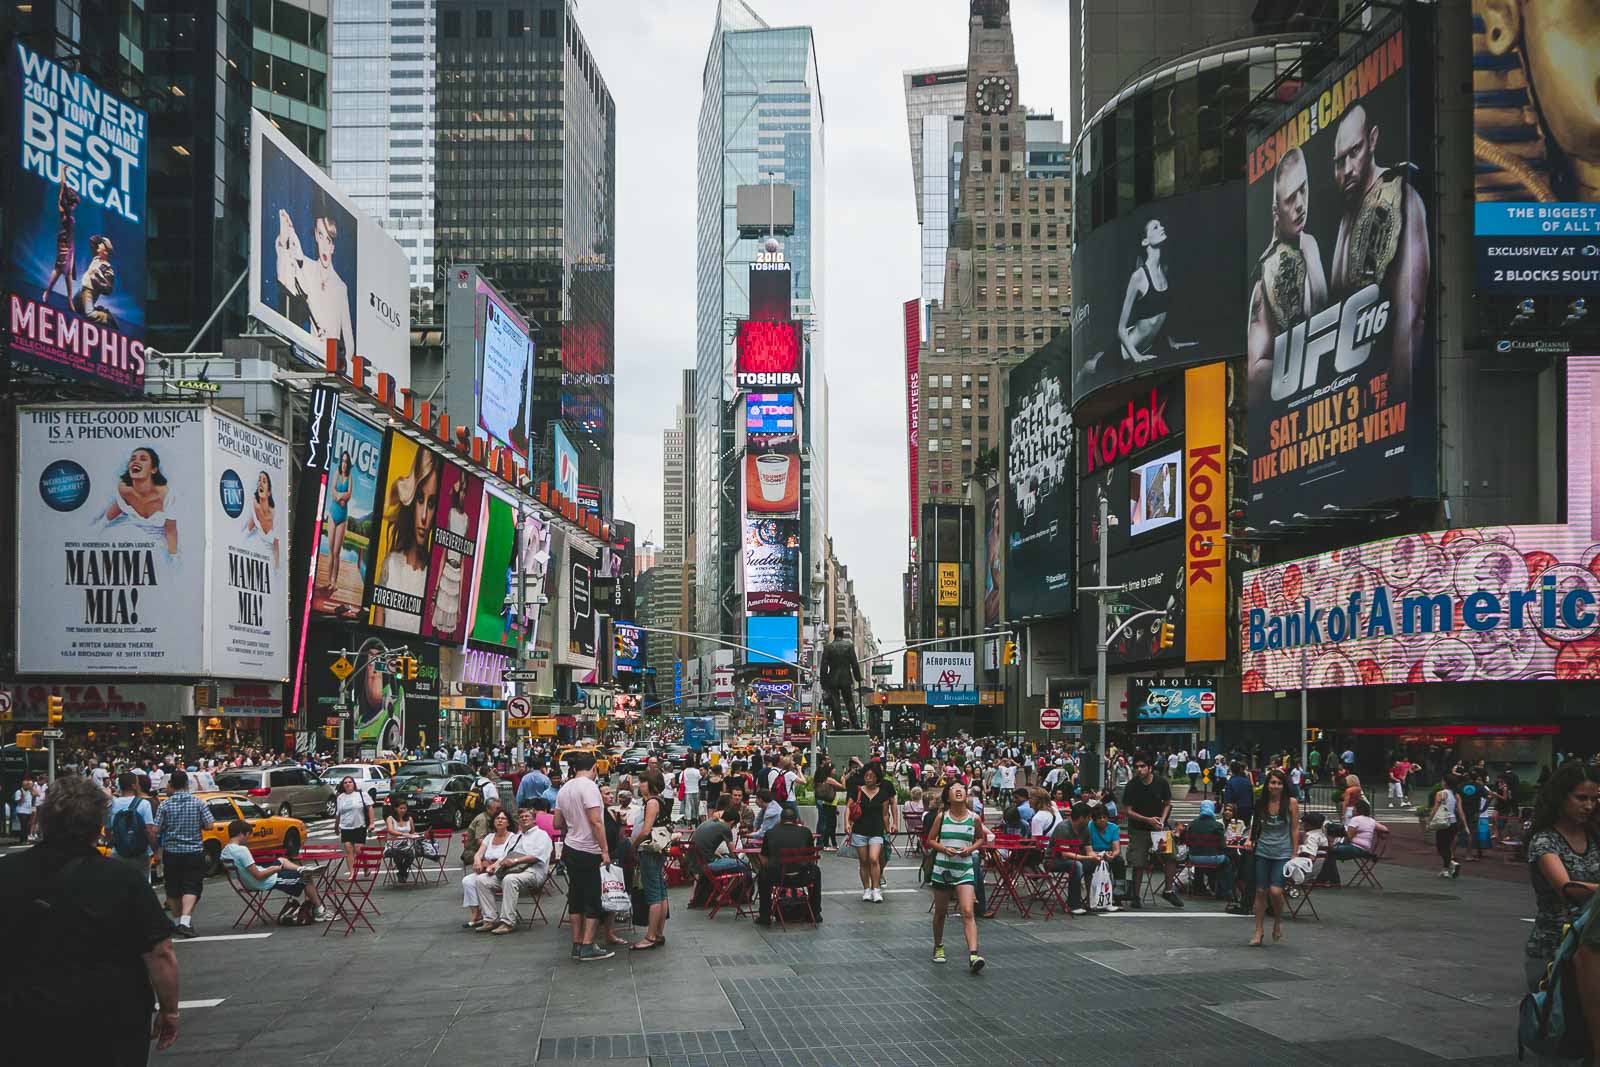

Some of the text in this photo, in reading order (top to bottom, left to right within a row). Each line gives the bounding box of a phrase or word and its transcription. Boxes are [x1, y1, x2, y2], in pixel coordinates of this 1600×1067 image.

[17, 42, 145, 138] WINNER!
[24, 77, 140, 154] 2010 TONY AWARD
[1248, 108, 1312, 185] LESNAR
[1318, 30, 1404, 130] CARWIN
[24, 98, 139, 193] BEST
[23, 145, 139, 222] MUSICAL
[1507, 207, 1597, 218] THE BIGGEST
[1541, 221, 1562, 232] OF
[1563, 221, 1591, 232] ALL
[750, 262, 791, 271] TOSHIBA
[756, 252, 784, 262] 2010
[1487, 246, 1559, 257] EXCLUSIVELY
[1560, 246, 1576, 257] AT
[1493, 269, 1504, 282] 2
[1506, 269, 1560, 282] BLOCKS
[375, 295, 401, 328] TOUS
[10, 296, 145, 376] MEMPHIS
[1270, 283, 1391, 401] UFC 116
[179, 381, 218, 391] LAMAR
[738, 373, 802, 384] TOSHIBA
[65, 410, 139, 424] FEEL-GOOD
[143, 410, 201, 424] MUSICAL
[910, 372, 919, 429] REUTERS
[48, 425, 181, 439] IS A PHENOMENON!"
[1087, 388, 1169, 473] Kodak
[1270, 386, 1360, 450] SAT. JULY 3
[218, 433, 251, 457] POPULAR
[265, 440, 283, 457] MOST
[334, 428, 380, 477] HUGE
[1251, 401, 1407, 485] LIVE ON PAY-PER-VIEW
[1189, 444, 1222, 585] Kodak
[65, 549, 157, 586] MAMMA
[228, 552, 271, 594] MAMMA
[84, 587, 139, 625] MIA!
[238, 590, 263, 626] MIA!
[373, 587, 422, 613] FOREVER21.COM
[747, 596, 799, 608] American Lager
[940, 590, 957, 600] KING
[1250, 596, 1325, 652] Bank
[1326, 592, 1363, 642] of
[925, 657, 972, 666] AÉROPOSTALE
[1135, 679, 1213, 687] MARQUIS
[1146, 691, 1169, 707] Come
[1165, 689, 1182, 708] Fly
